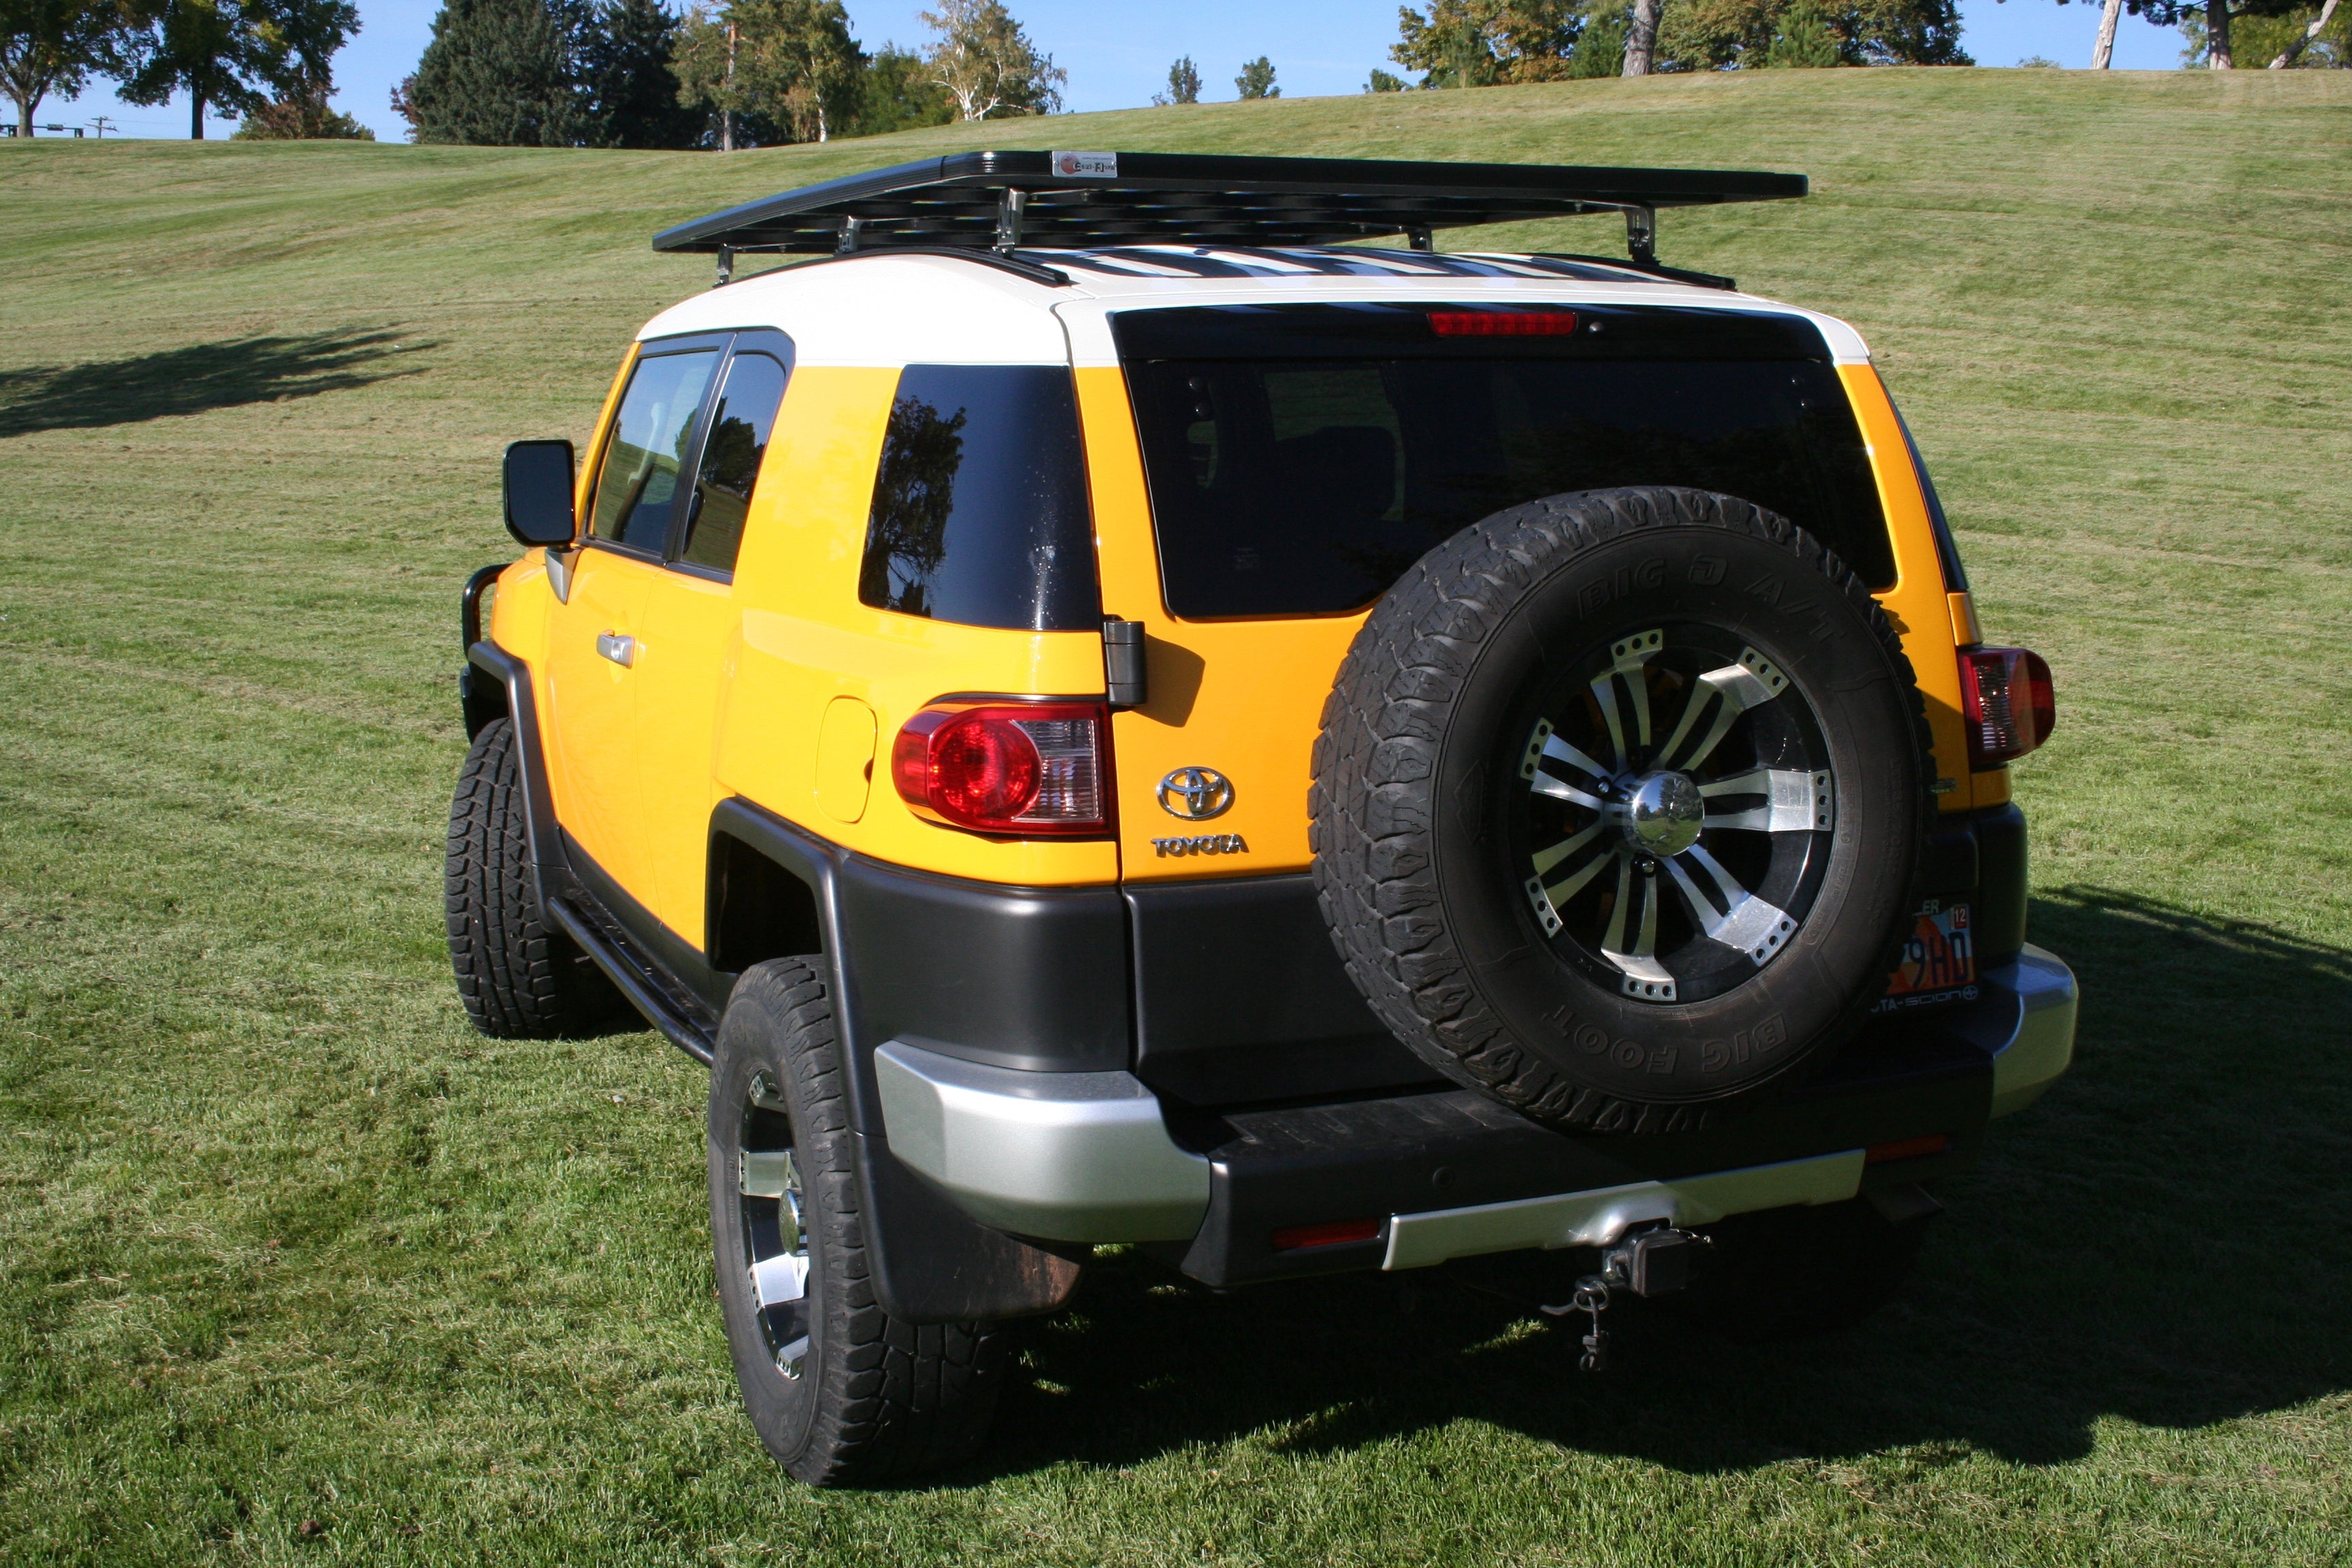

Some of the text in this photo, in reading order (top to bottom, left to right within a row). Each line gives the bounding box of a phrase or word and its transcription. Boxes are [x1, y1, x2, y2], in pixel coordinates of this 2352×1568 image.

[1576, 557, 1667, 620] BIG
[1151, 834, 1243, 855] TOYOTA
[1954, 908, 1966, 924] 12
[1541, 1004, 1789, 1076] BIG FOOT
